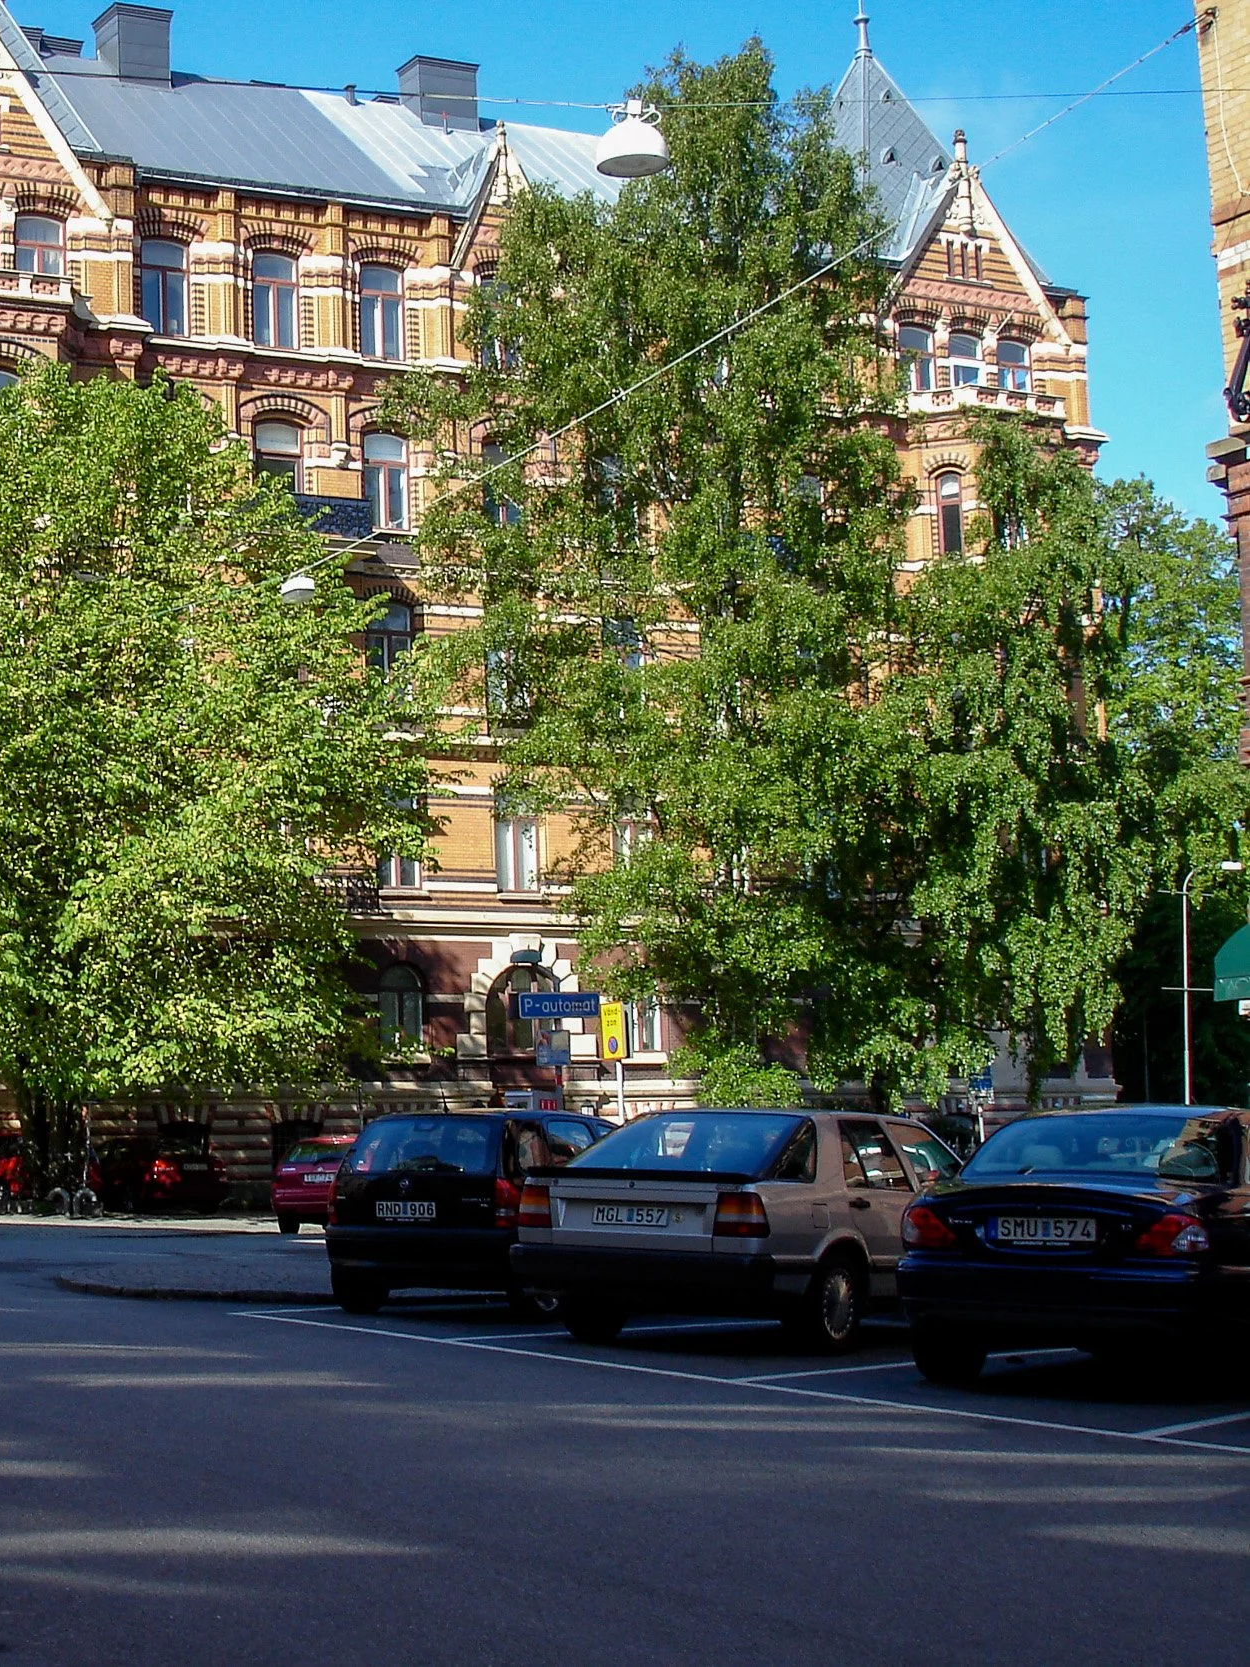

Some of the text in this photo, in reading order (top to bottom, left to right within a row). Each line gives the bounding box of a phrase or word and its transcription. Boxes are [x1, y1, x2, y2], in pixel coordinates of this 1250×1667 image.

[524, 998, 596, 1013] P-automat
[377, 1203, 435, 1216] RND 906
[596, 1207, 665, 1224] MGL 557
[1001, 1219, 1092, 1239] SMU 574
